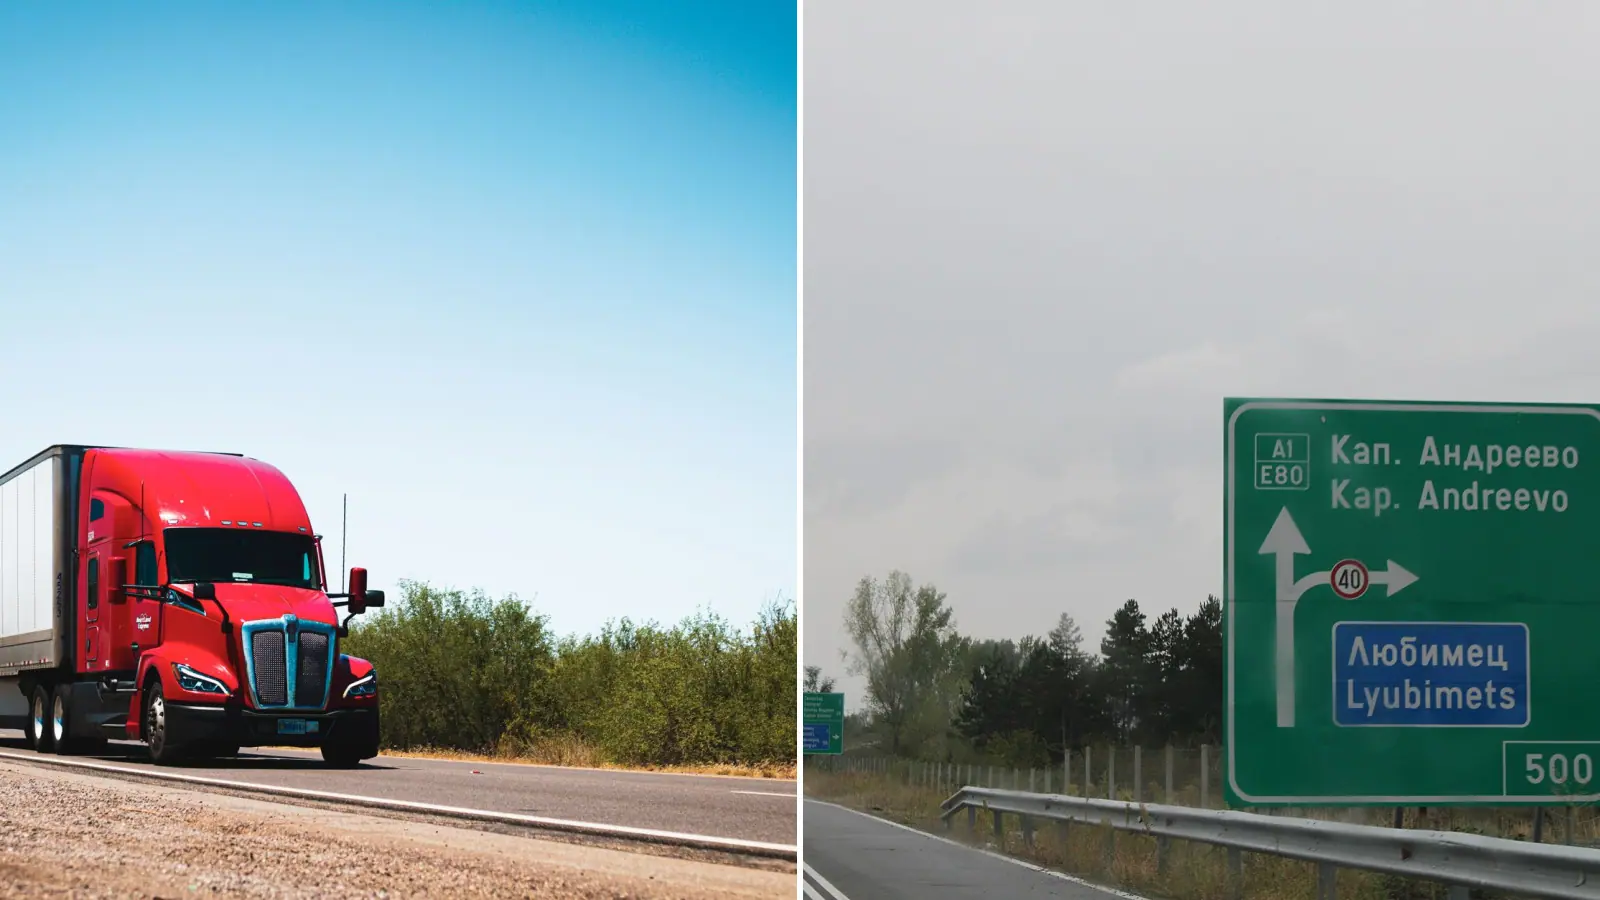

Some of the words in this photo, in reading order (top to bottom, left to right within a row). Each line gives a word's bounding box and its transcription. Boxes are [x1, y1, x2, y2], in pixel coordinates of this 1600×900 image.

[1271, 438, 1293, 459] A1
[1331, 434, 1401, 465] Кап.
[1419, 435, 1579, 474] Андреево
[1261, 464, 1303, 486] E80
[1331, 478, 1400, 517] Kap.
[1418, 479, 1569, 513] Andreevo
[1338, 568, 1361, 590] 40
[1348, 635, 1508, 671] Любимец
[1347, 678, 1516, 717] Lyubimets
[1526, 753, 1593, 785] 500
